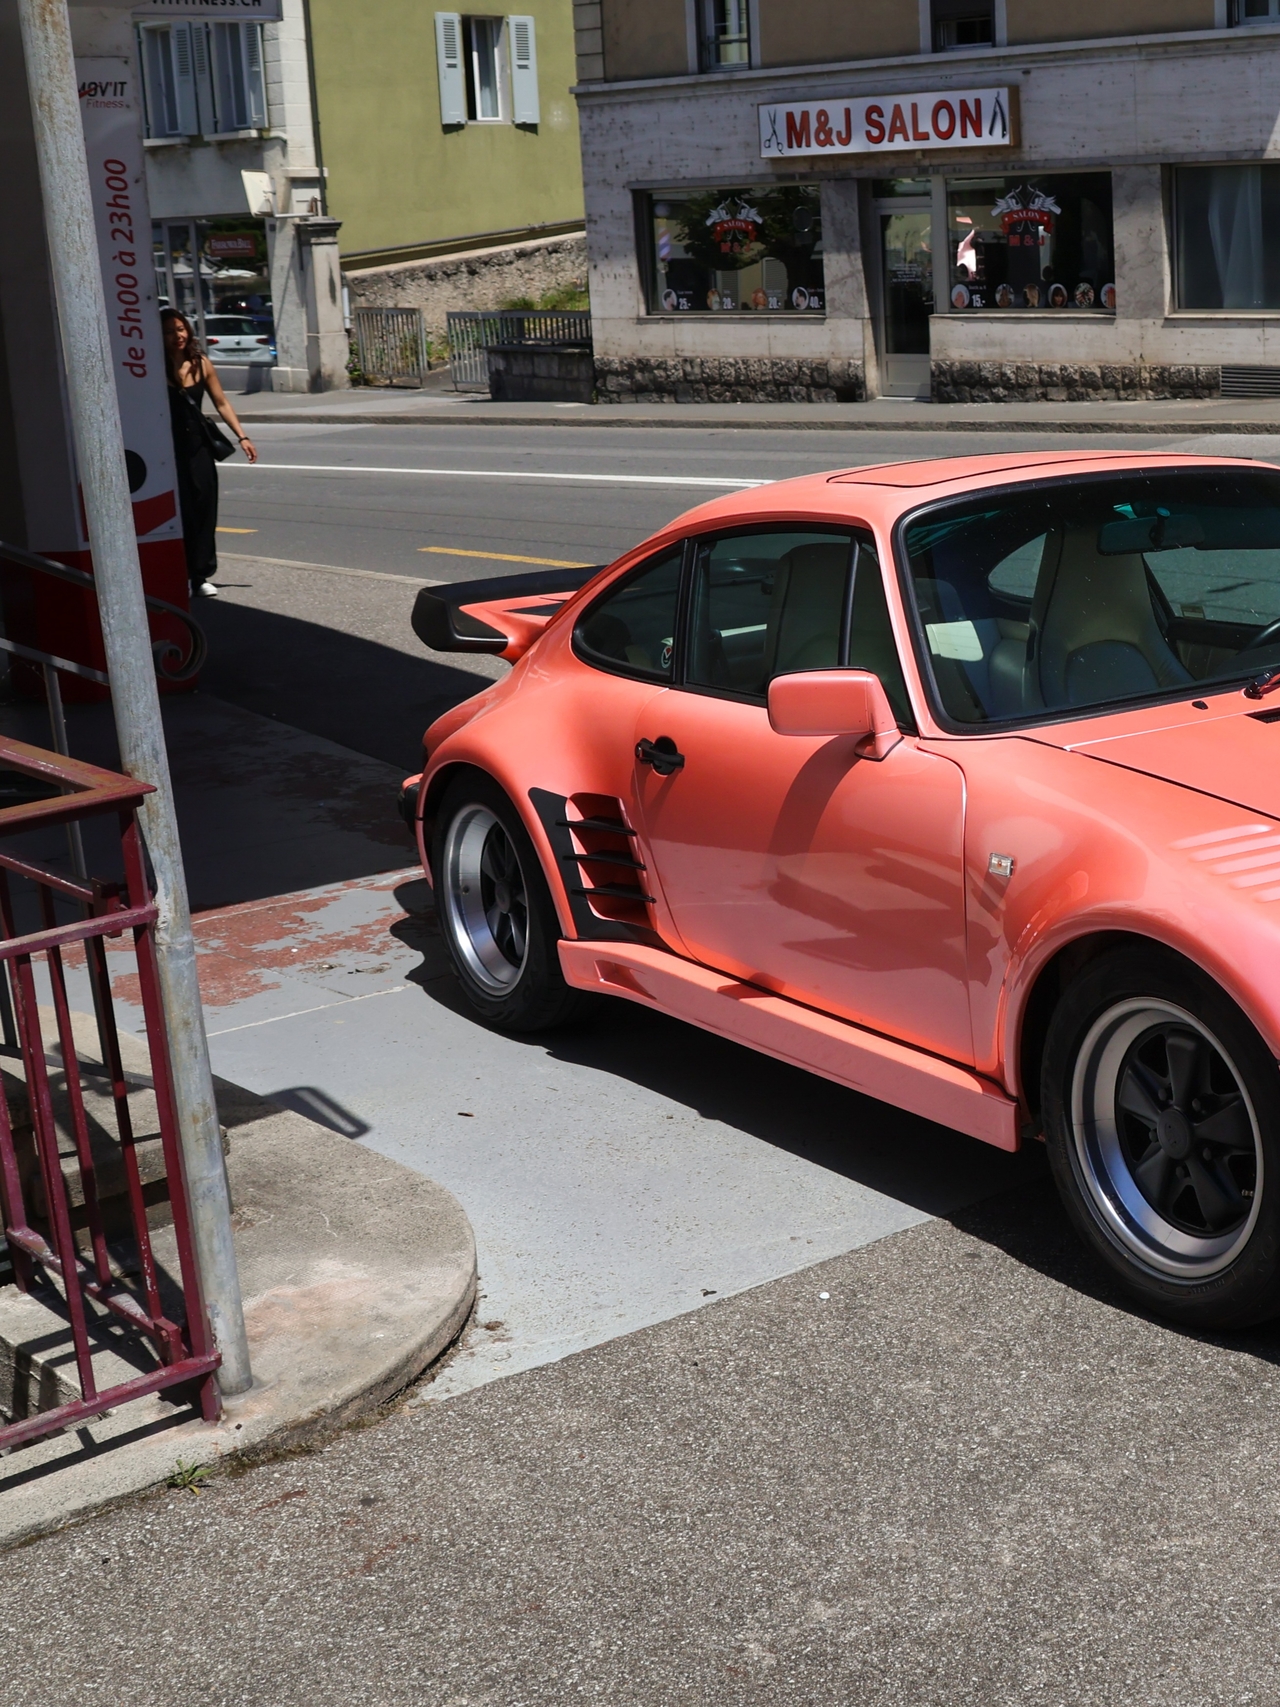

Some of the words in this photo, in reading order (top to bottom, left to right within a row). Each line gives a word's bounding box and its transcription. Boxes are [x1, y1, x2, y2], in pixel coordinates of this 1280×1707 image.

[86, 99, 124, 108] Fitness
[785, 107, 852, 148] M&J
[865, 98, 983, 144] SALON
[104, 158, 135, 244] 23h00
[723, 220, 746, 228] SALON
[1013, 211, 1039, 220] SALON
[112, 251, 136, 267] à
[115, 273, 143, 340] 5h00
[122, 347, 147, 378] de
